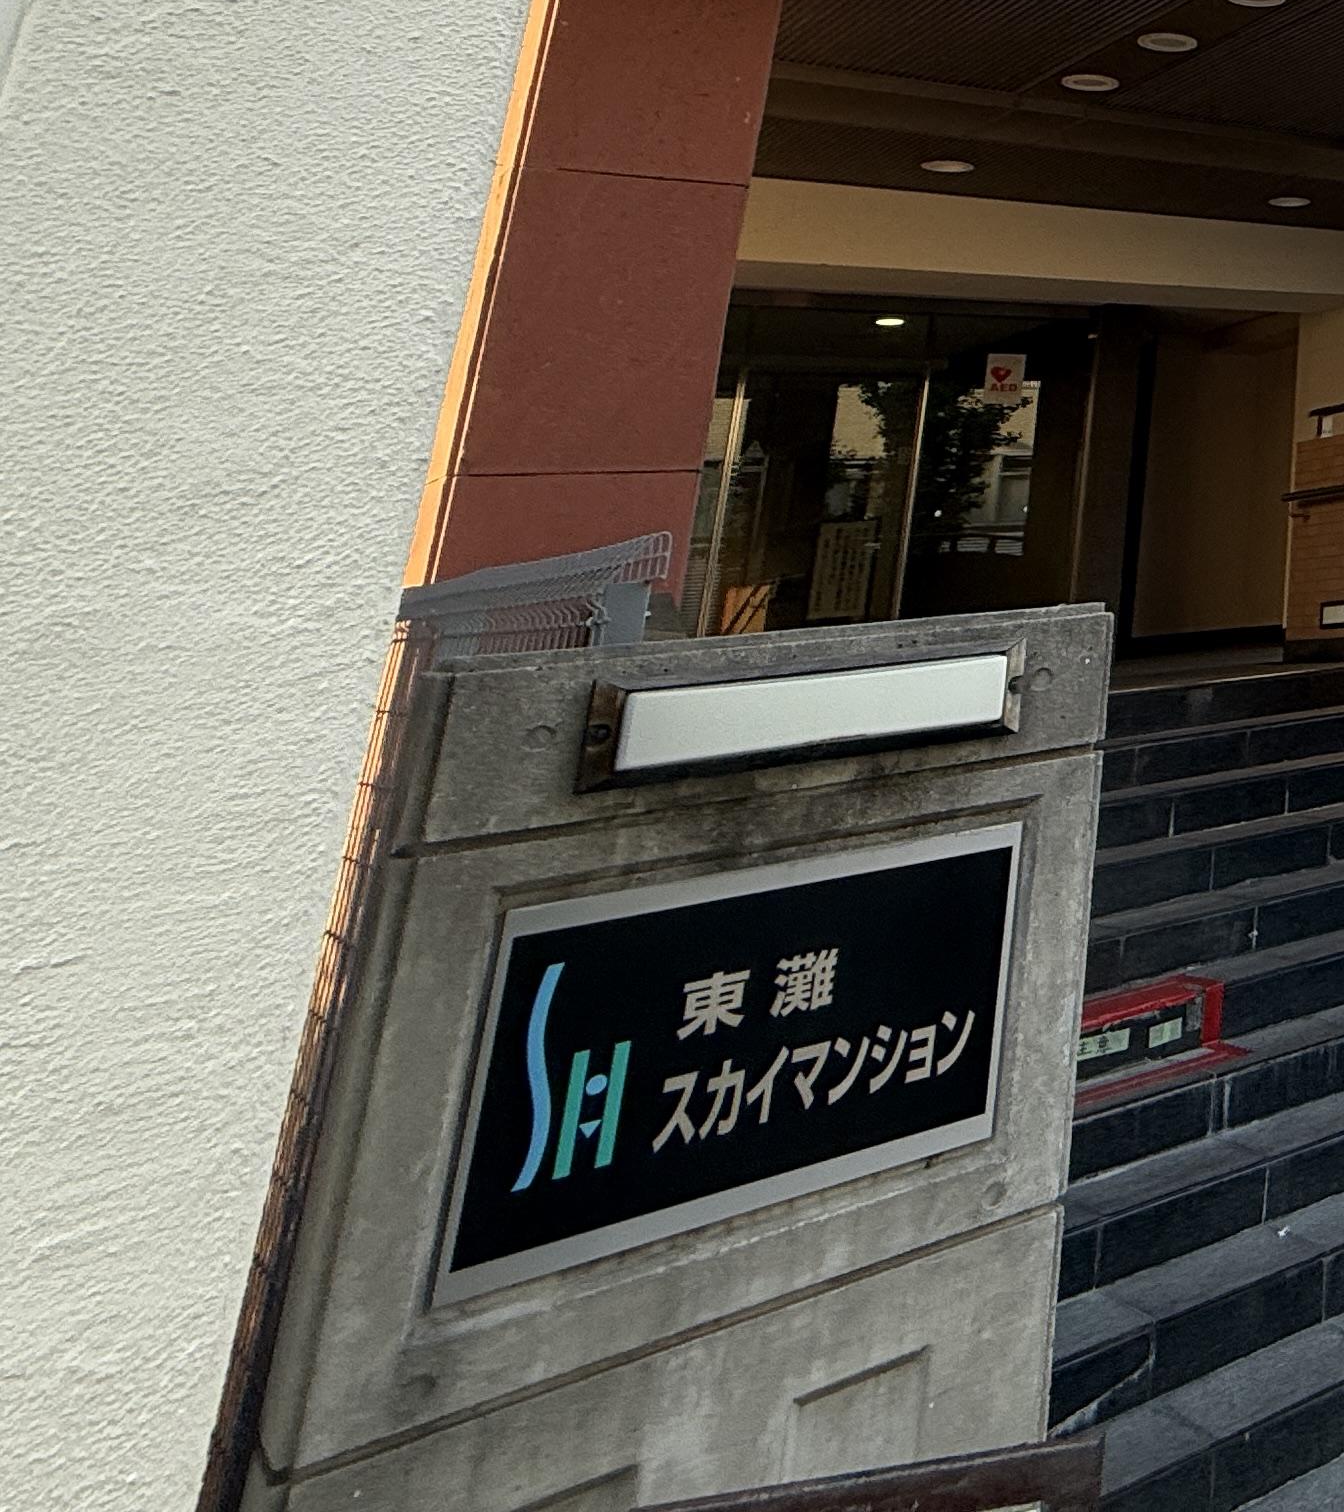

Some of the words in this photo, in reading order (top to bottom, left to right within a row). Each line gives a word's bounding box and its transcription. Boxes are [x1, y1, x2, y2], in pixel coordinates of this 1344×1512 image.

[652, 1009, 976, 1153] スカイマンション
